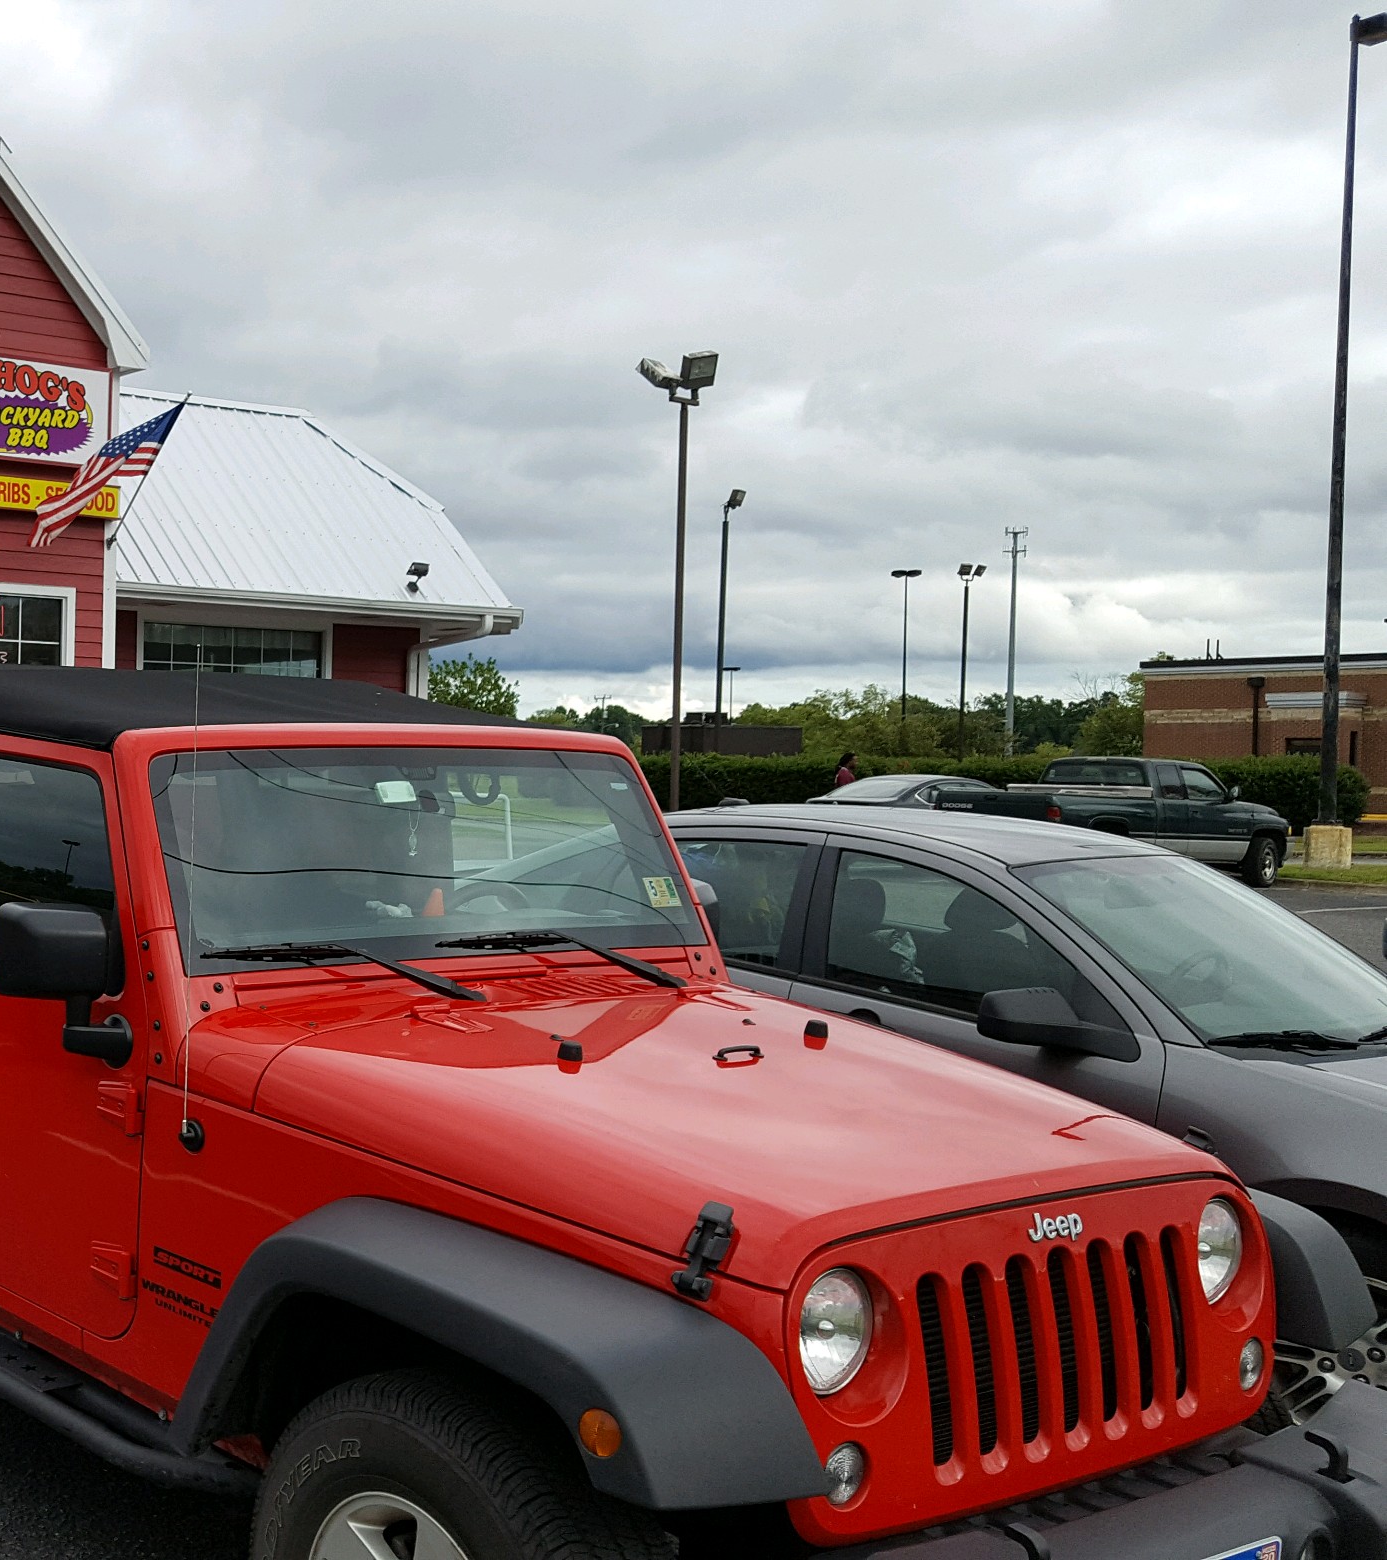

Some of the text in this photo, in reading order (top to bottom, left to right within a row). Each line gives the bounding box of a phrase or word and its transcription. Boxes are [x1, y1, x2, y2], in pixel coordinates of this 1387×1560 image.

[6, 428, 50, 450] BBQ
[1028, 1212, 1083, 1242] Jeep
[155, 1250, 221, 1282] SPORT
[142, 1278, 220, 1318] WRANGLE
[155, 1297, 212, 1329] UNLIMITE
